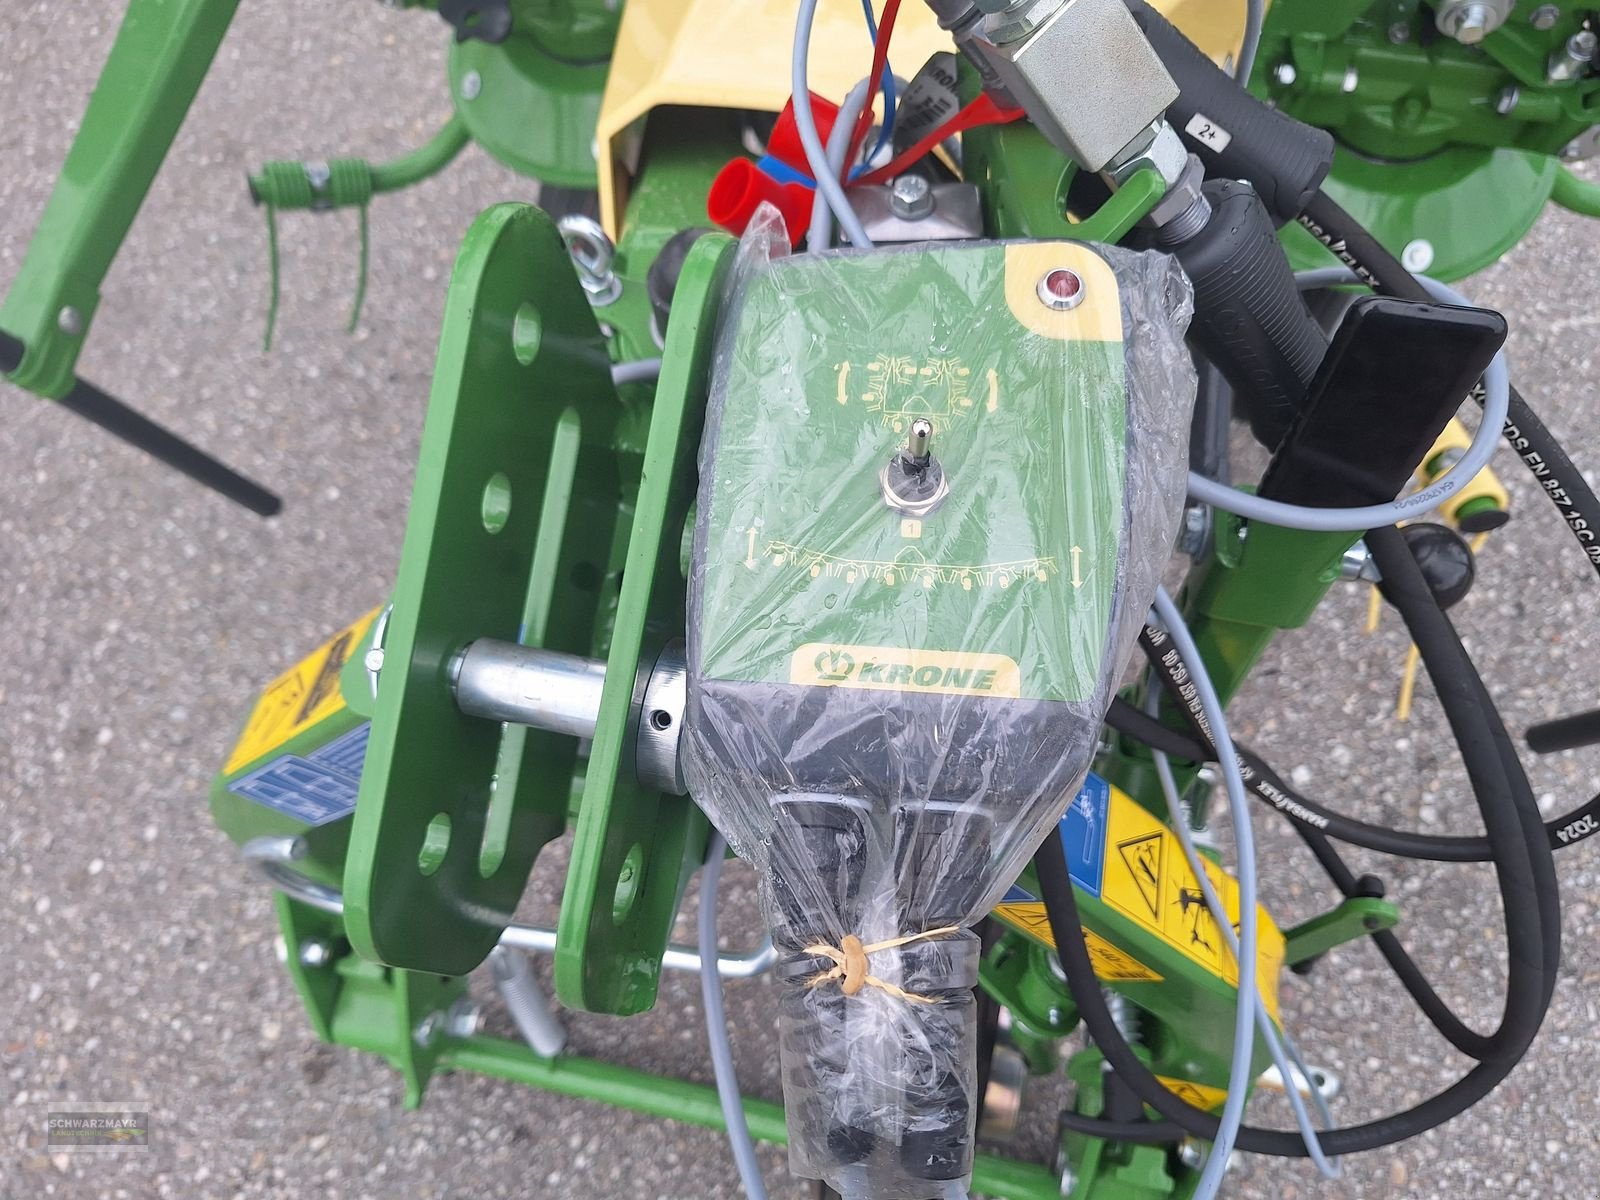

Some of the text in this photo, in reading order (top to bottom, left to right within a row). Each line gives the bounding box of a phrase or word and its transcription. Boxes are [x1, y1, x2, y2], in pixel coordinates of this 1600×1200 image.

[1198, 124, 1216, 140] 2+
[1523, 451, 1550, 476] EN
[1543, 479, 1572, 506] 857
[1565, 510, 1595, 542] 1SC
[907, 522, 915, 535] 1
[1161, 648, 1179, 667] 08
[857, 662, 998, 690] KRONE
[1178, 681, 1198, 700] 857
[1556, 813, 1599, 842] 2Q24
